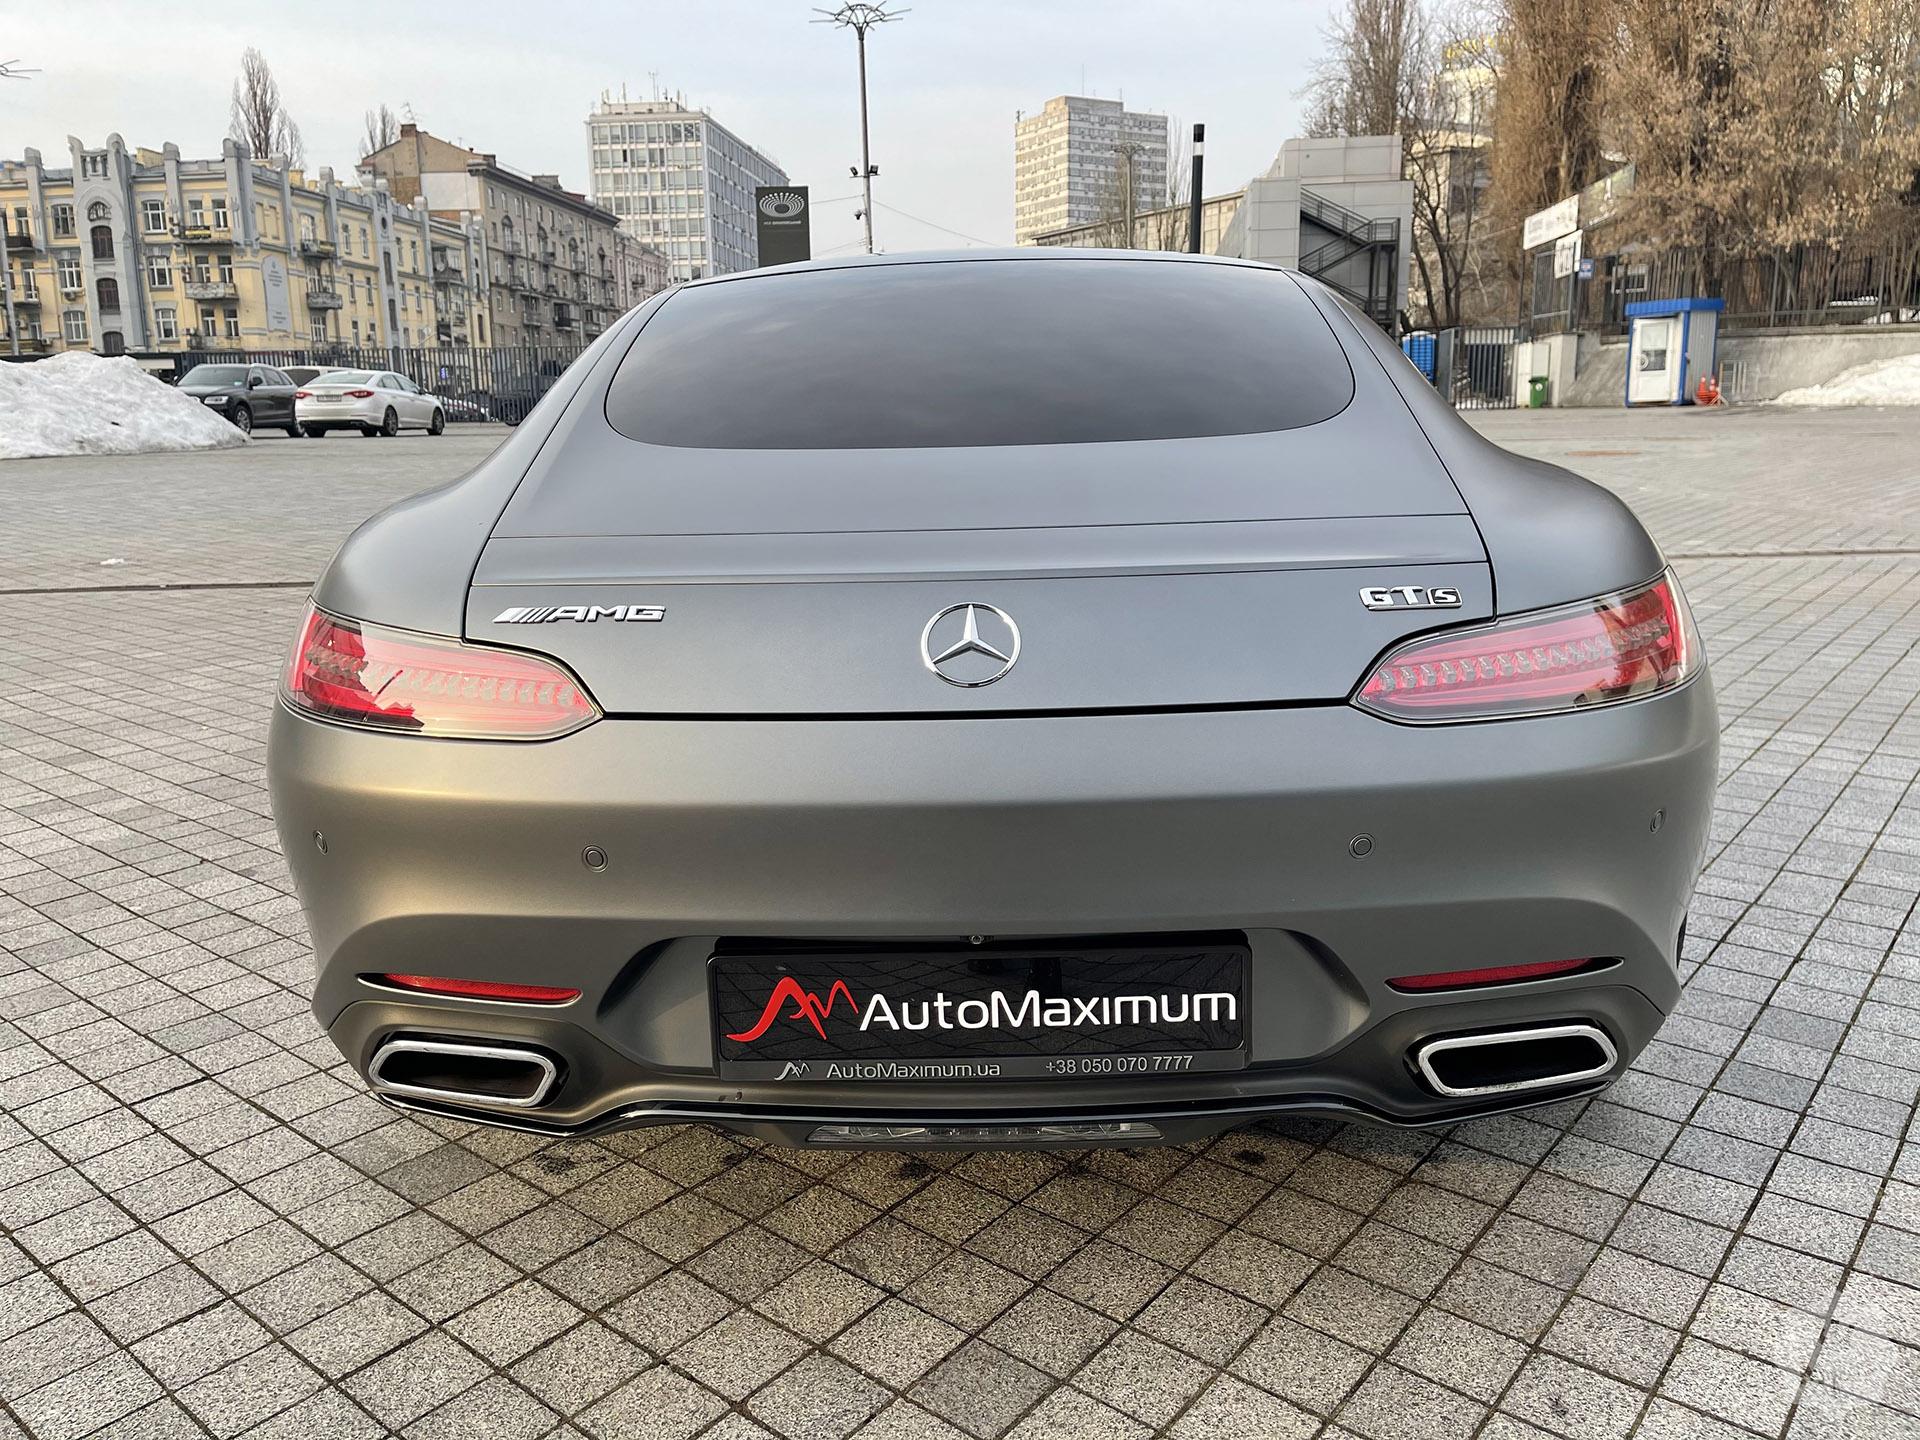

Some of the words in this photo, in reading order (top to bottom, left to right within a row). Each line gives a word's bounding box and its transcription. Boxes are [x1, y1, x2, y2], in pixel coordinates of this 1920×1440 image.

[545, 605, 667, 623] AMG
[859, 989, 1237, 1032] AutoMaximum
[826, 1061, 1001, 1079] AutoMaximum.ua
[1045, 1060, 1077, 1074] +38
[1081, 1058, 1112, 1073] 050
[1117, 1057, 1148, 1072] 070
[1152, 1055, 1193, 1071] 7777
